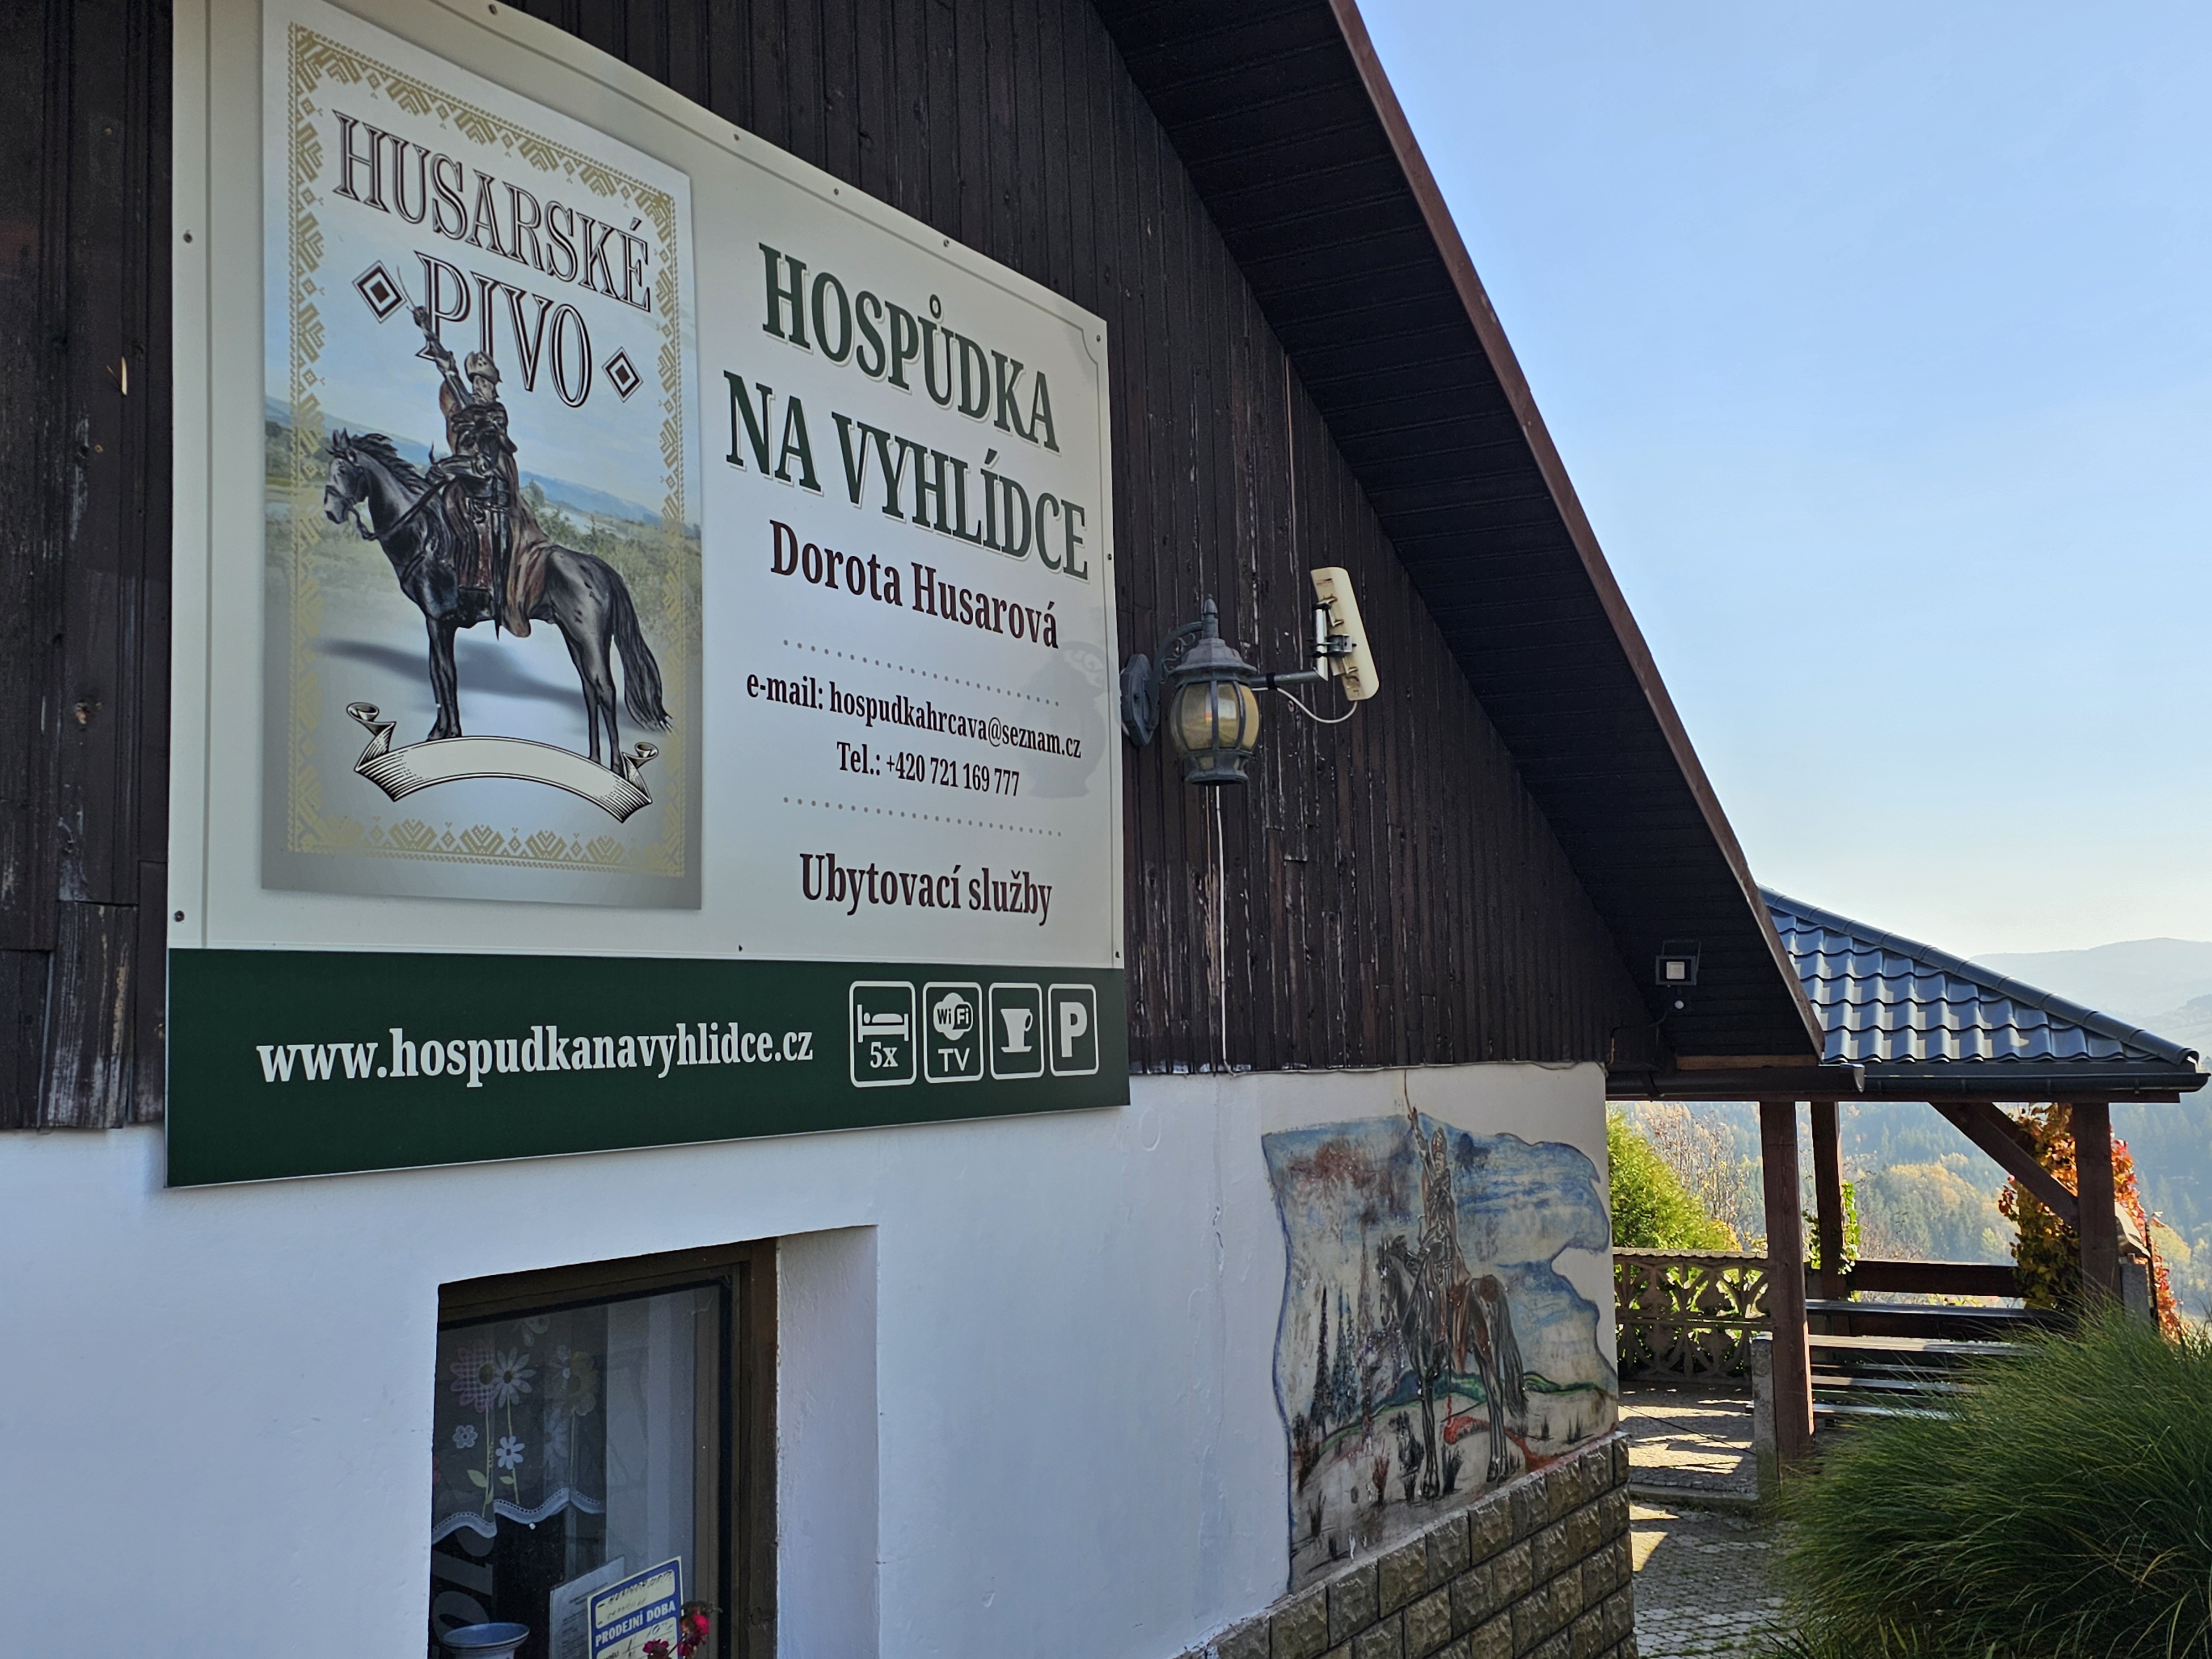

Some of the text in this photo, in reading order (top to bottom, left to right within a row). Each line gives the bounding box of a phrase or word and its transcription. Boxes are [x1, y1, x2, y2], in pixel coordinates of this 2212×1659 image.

[332, 109, 651, 313] HUSARSKÉ
[414, 251, 593, 408] PIVO
[759, 242, 1060, 453] HOSPŮDKA
[723, 370, 1088, 581] NA VYHLÍDCE
[770, 519, 1058, 649] Dorota Husarová
[747, 672, 1081, 759] e-mail: hospudkahrcava@seznam.cz
[837, 741, 1020, 796] Tel.: +420 721 169 777
[800, 853, 1052, 926] Ubytovací služby
[257, 1022, 813, 1087] www.hospudkanavyhlidce.cz
[870, 1042, 898, 1068] 5x
[938, 1048, 970, 1072] TV
[1060, 1002, 1087, 1057] P
[596, 1610, 643, 1647] PRODEJNÍ
[646, 1600, 676, 1623] DOBA
